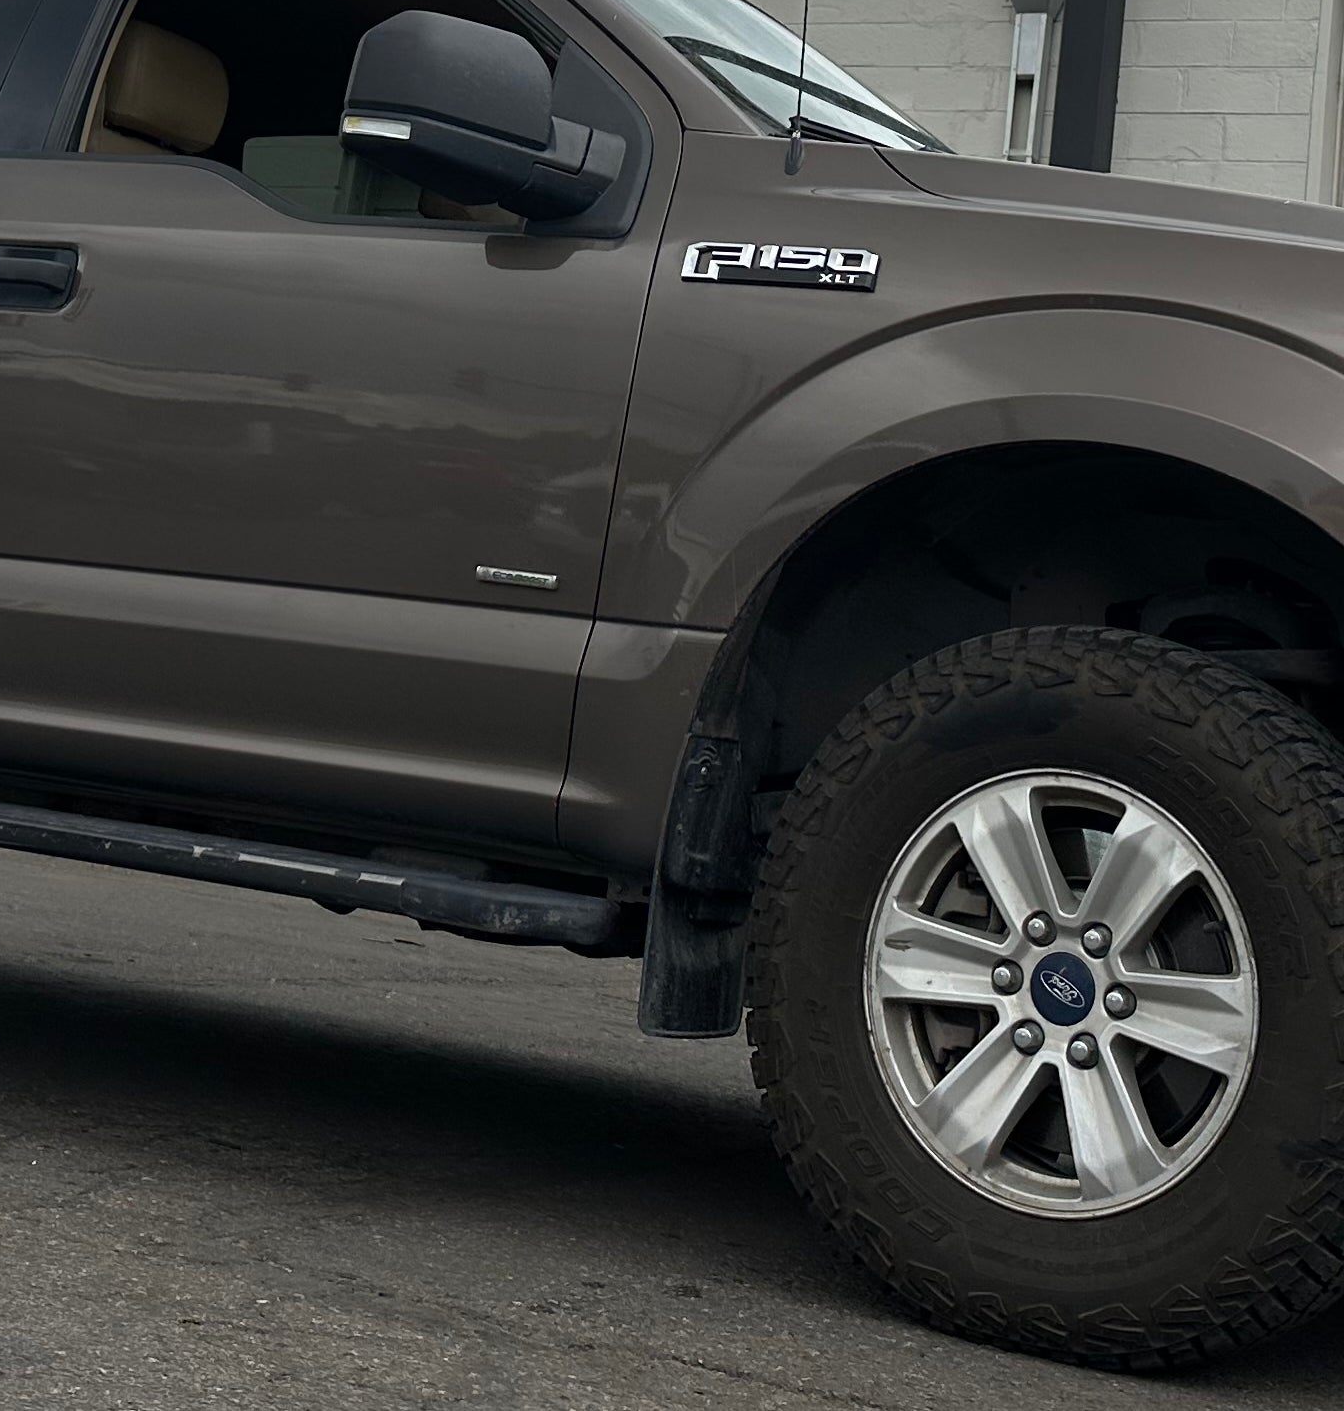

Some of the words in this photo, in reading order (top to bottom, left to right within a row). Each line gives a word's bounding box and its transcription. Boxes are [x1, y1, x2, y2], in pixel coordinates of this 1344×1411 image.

[681, 242, 878, 280] F150
[818, 273, 860, 284] XLT
[1047, 975, 1078, 1001] Ford
